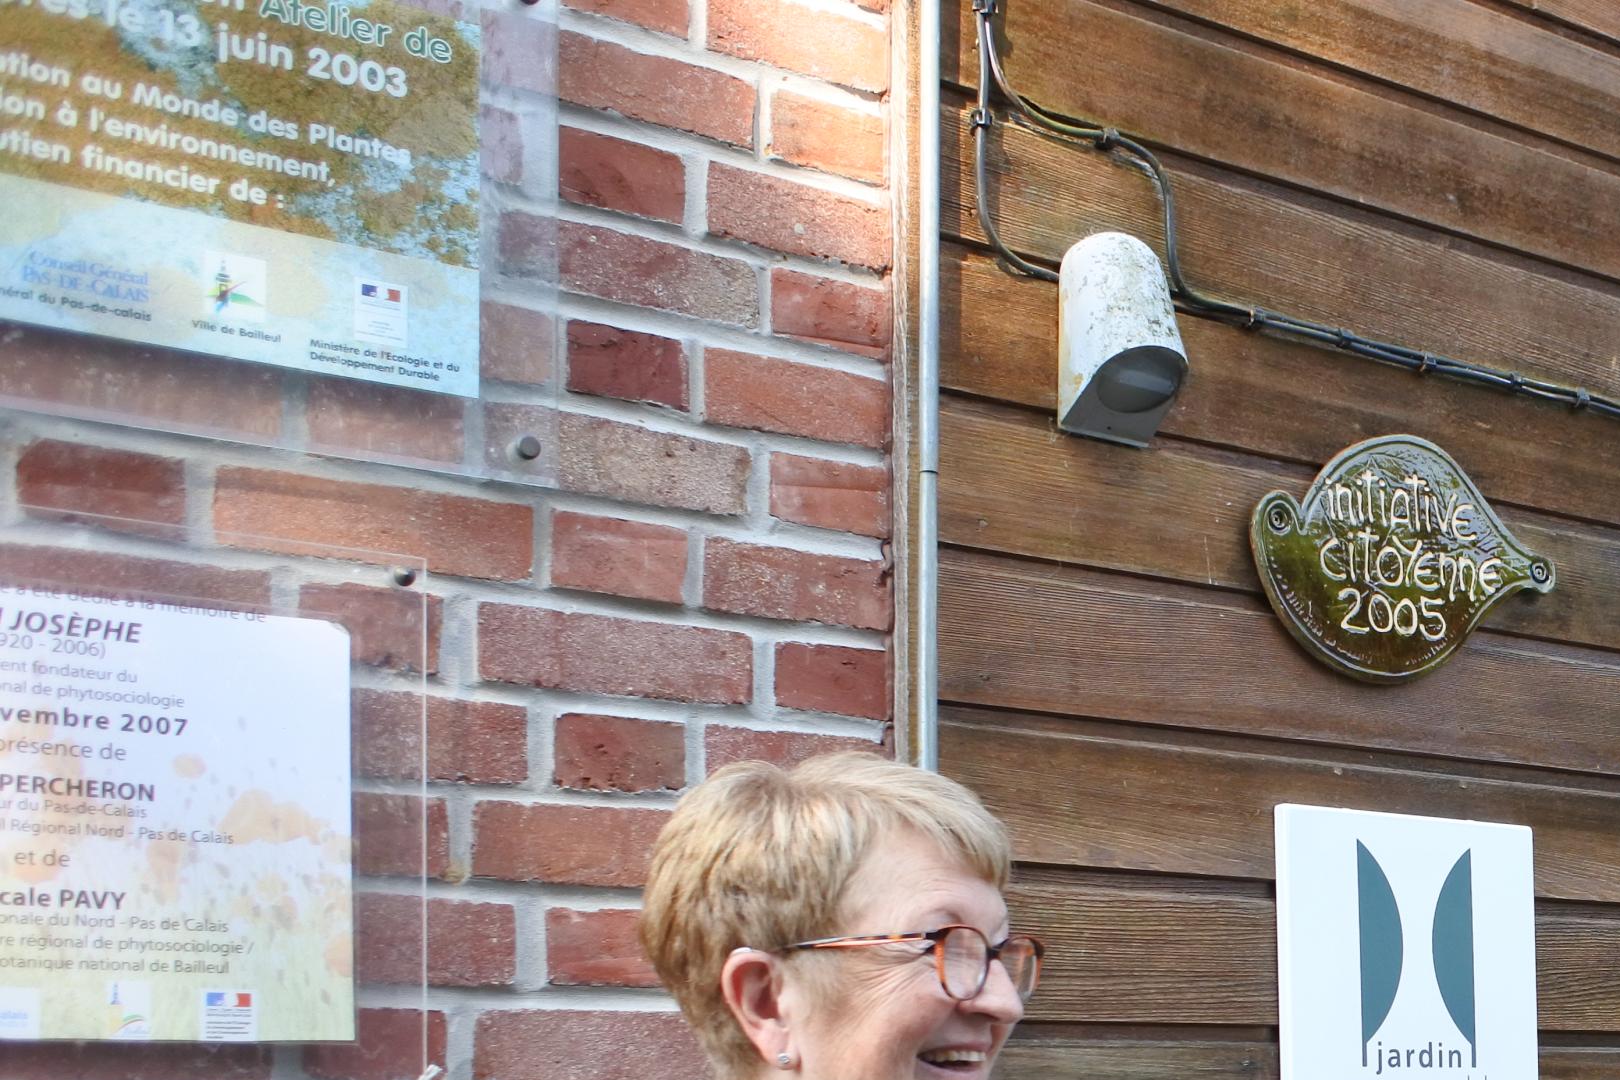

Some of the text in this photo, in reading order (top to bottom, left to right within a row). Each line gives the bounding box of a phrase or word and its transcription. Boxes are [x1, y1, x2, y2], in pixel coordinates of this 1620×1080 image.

[159, 8, 201, 48] 13
[216, 22, 294, 71] juin
[307, 47, 408, 98] 2003
[403, 25, 454, 64] de
[80, 74, 123, 99] au
[132, 81, 240, 127] Monde
[248, 109, 299, 141] des
[308, 122, 412, 167] Plantes
[57, 99, 78, 127] à
[89, 106, 336, 187] l'environnement,
[81, 143, 221, 195] financier
[229, 177, 268, 205] de
[38, 293, 56, 305] du
[191, 318, 282, 344] Ville de Bailleul
[310, 338, 361, 357] Ministère
[363, 346, 378, 358] de
[433, 358, 444, 370] et
[447, 360, 461, 373] du
[310, 350, 441, 383] Développement Durable
[9, 611, 143, 643] JOSÈPHE
[244, 607, 266, 622] de
[1337, 588, 1446, 641] 2005
[52, 637, 107, 660] 2006)
[32, 660, 112, 682] fondateur
[117, 669, 138, 684] du
[32, 682, 52, 697] de
[57, 685, 185, 711] phytosociologie
[0, 705, 189, 737] vembre 2007
[99, 742, 127, 761] de
[0, 773, 156, 801] PERCHERON
[18, 798, 38, 811] du
[44, 800, 147, 818] Pas-de-Calais
[10, 818, 81, 836] Régional
[85, 821, 125, 838] Nord
[138, 827, 164, 841] Pas
[168, 829, 186, 842] de
[191, 830, 235, 845] Calais
[14, 849, 71, 867] et de
[0, 887, 126, 910] cale PAVY
[50, 912, 70, 926] du
[75, 913, 115, 928] Nord
[129, 916, 156, 930] Pas
[160, 917, 180, 931] de
[183, 918, 229, 933] Calais
[20, 934, 88, 952] régional
[93, 936, 113, 950] de
[118, 936, 244, 957] phytosociologie
[78, 956, 145, 972] national
[149, 959, 169, 973] de
[174, 959, 230, 975] Bailleul
[1375, 1041, 1462, 1075] jardin
